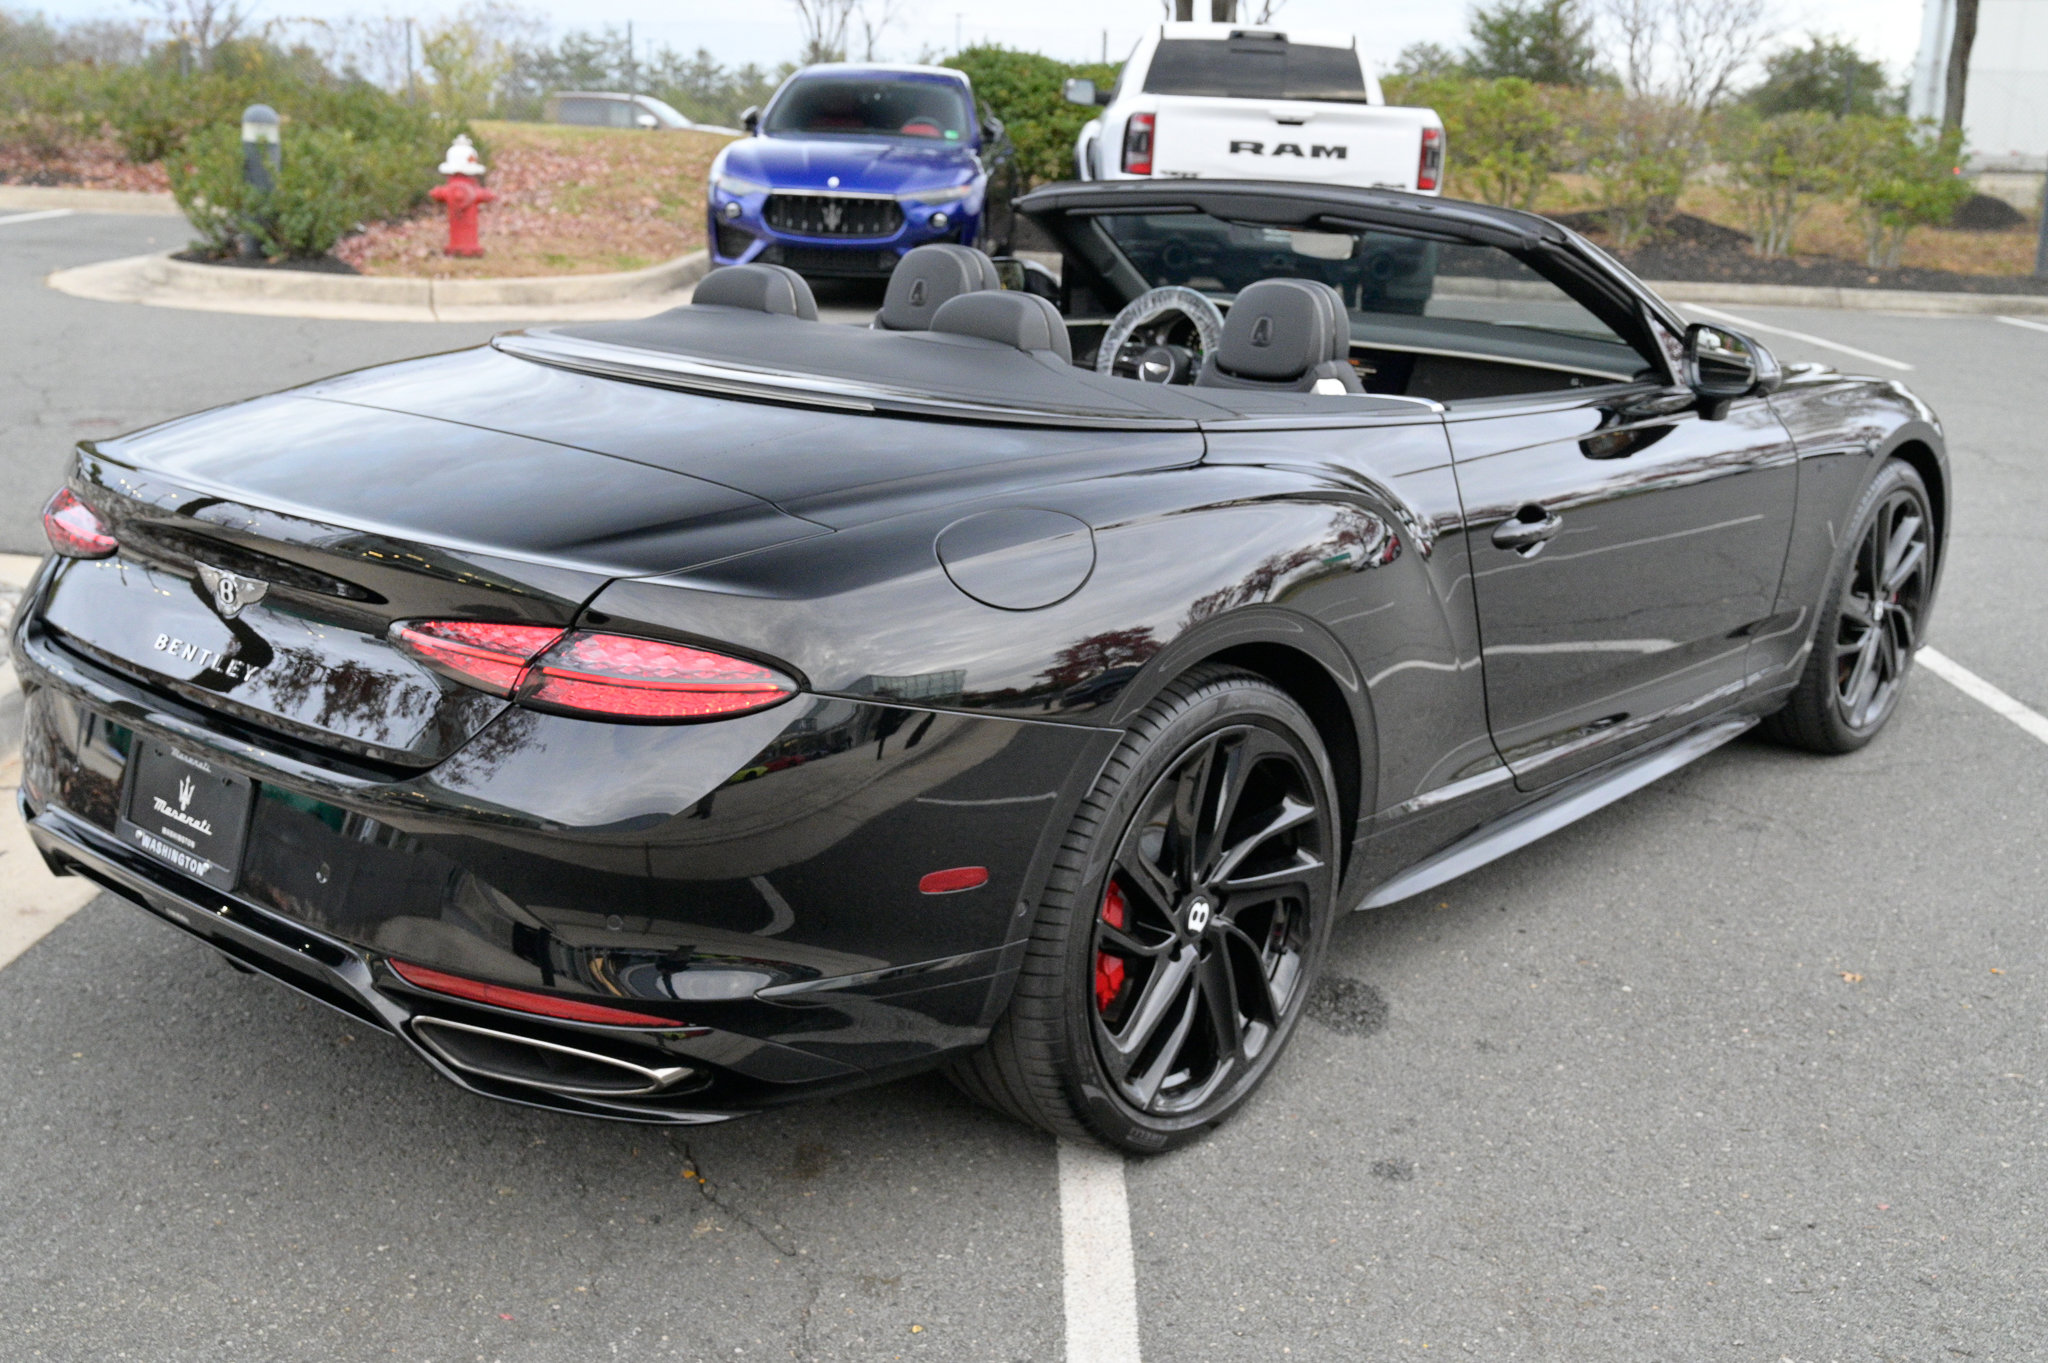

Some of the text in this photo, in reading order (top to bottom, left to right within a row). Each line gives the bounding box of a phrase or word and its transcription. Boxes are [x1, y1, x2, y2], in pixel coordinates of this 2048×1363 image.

[1229, 140, 1348, 160] RAM
[220, 578, 235, 604] B
[154, 632, 259, 682] BENTLEY
[153, 796, 213, 836] Maserati
[140, 834, 207, 877] WASHINGTON
[1187, 901, 1210, 933] B
